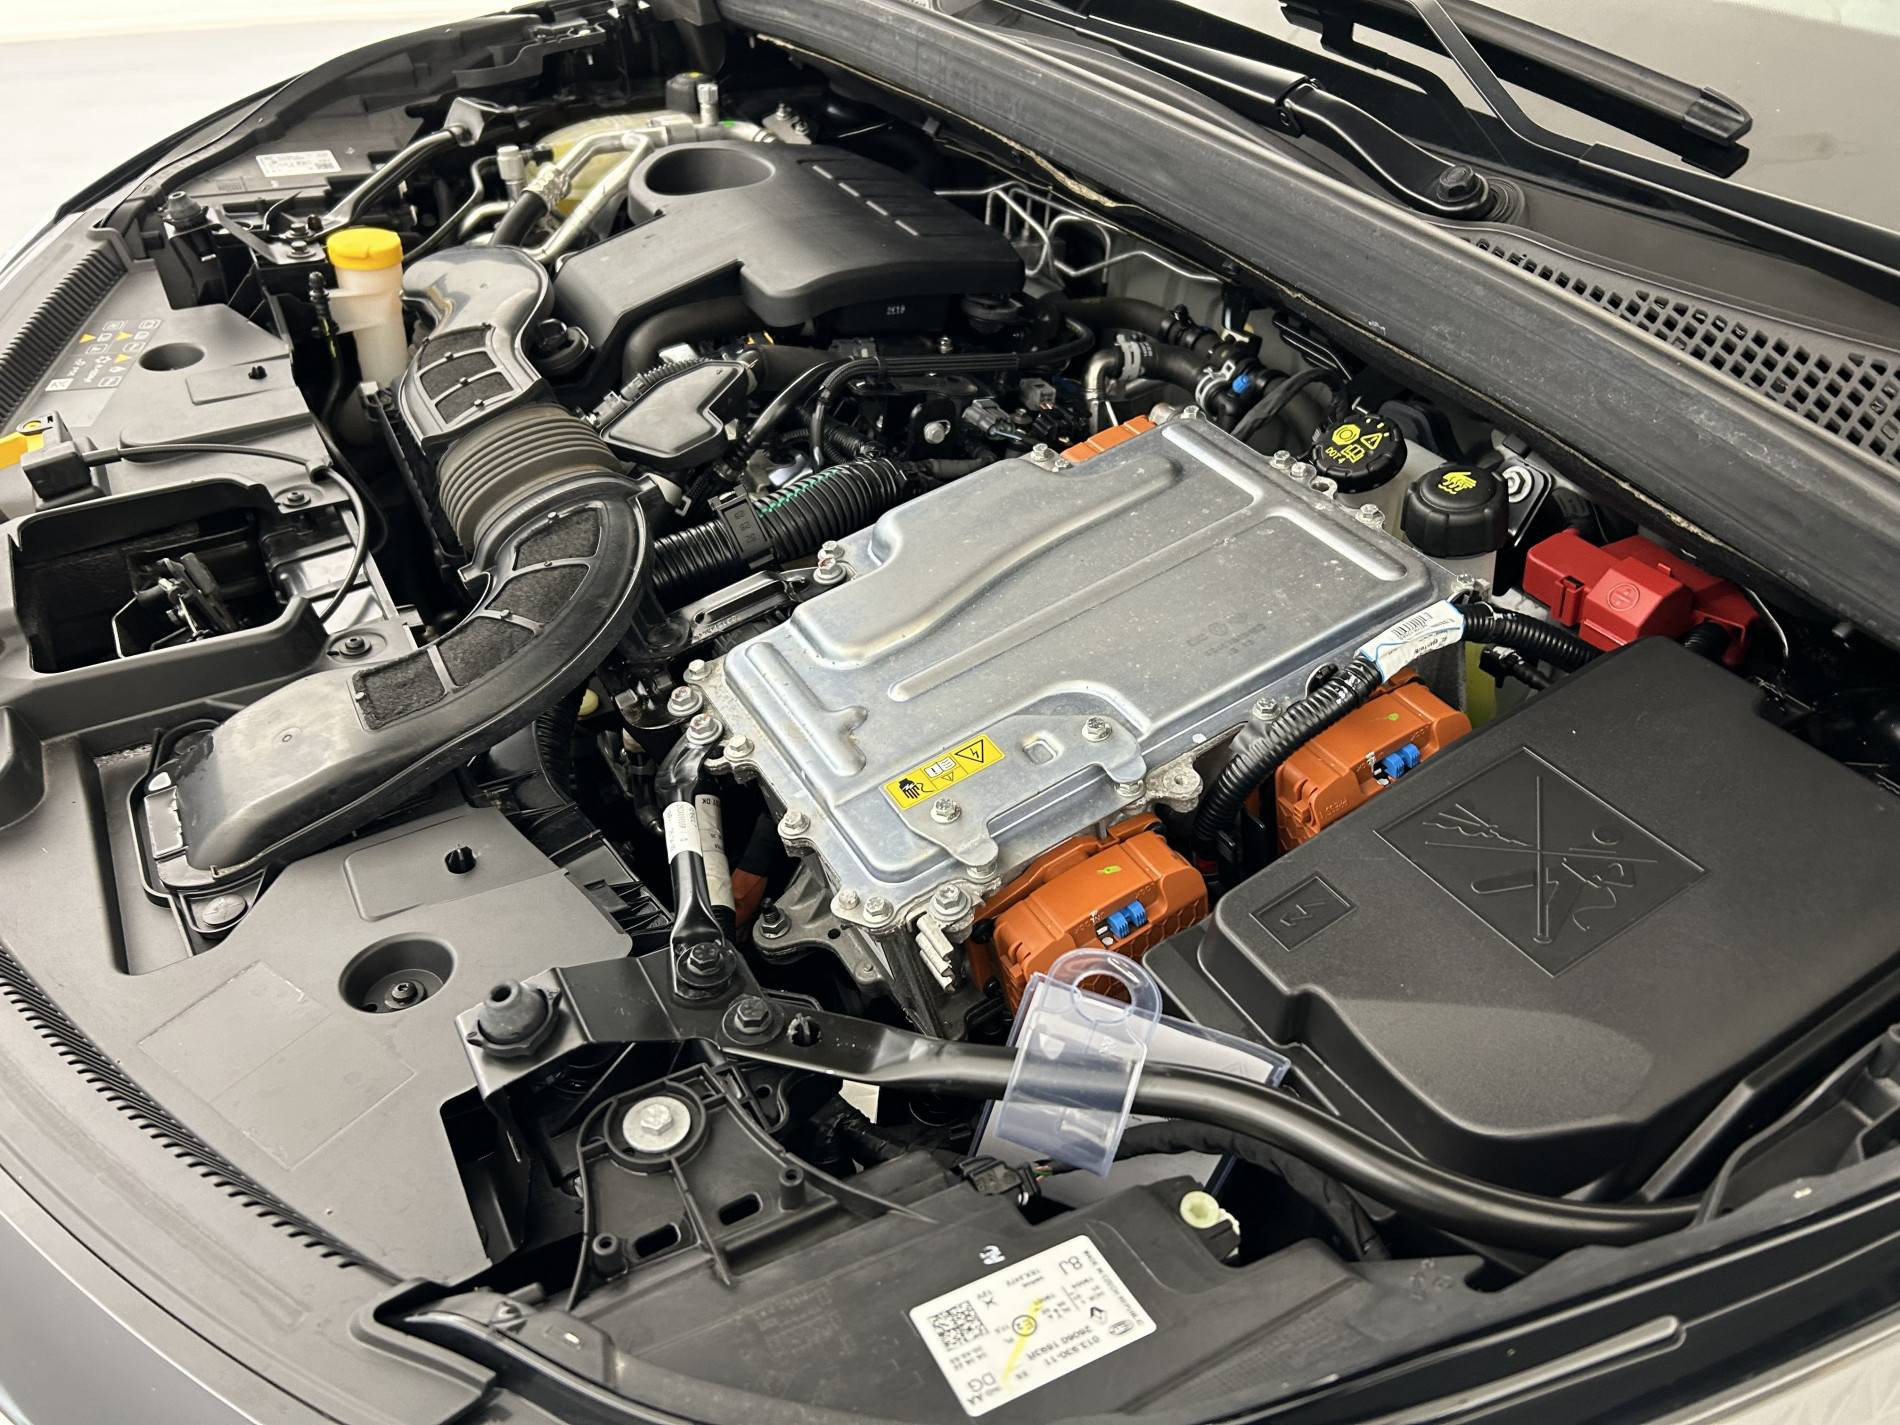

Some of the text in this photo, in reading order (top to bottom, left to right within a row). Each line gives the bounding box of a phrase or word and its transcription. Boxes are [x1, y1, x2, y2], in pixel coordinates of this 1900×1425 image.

[1325, 446, 1341, 459] DOT
[1058, 1256, 1083, 1275] 8J
[967, 1372, 996, 1393] DG
